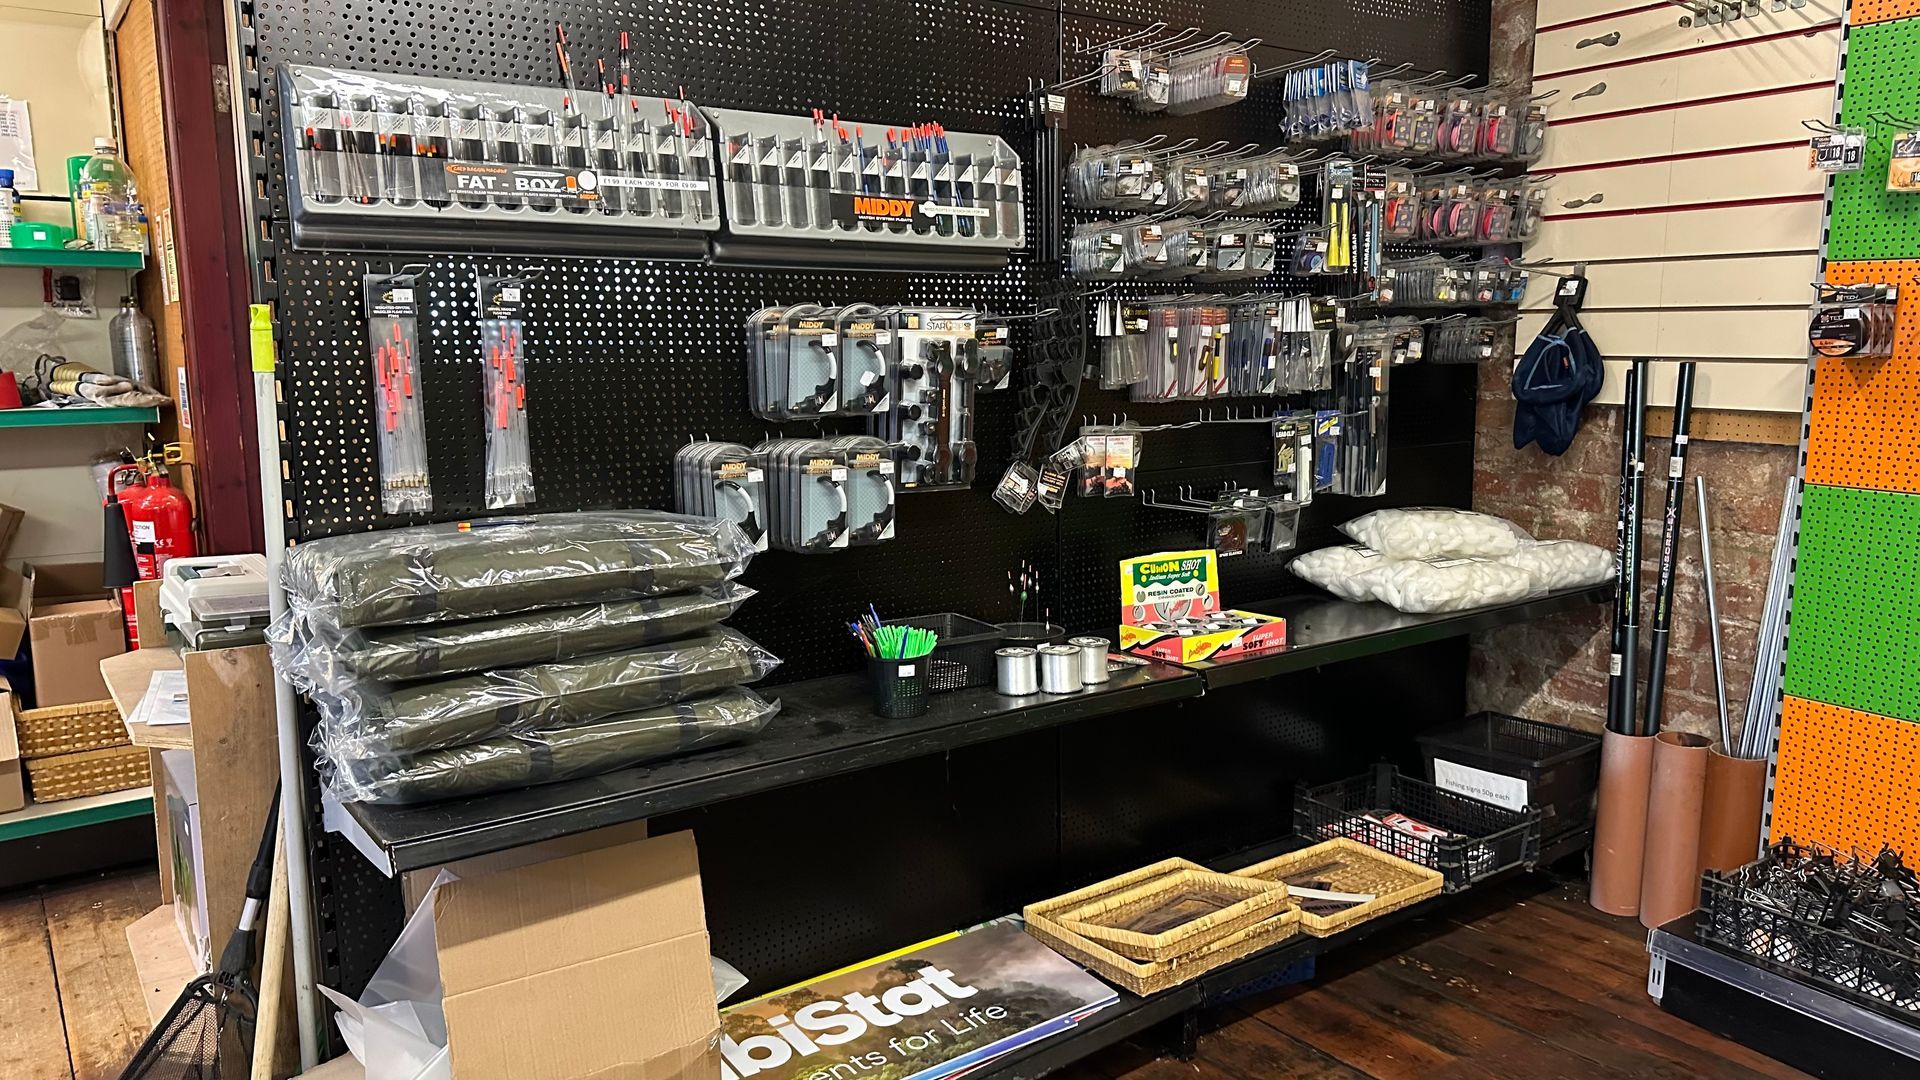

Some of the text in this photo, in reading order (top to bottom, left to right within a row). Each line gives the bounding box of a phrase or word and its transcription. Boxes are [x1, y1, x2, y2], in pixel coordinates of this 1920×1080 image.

[1833, 147, 1840, 157] 18
[1848, 151, 1856, 161] 18
[457, 175, 496, 190] FAT
[515, 178, 559, 192] BOY
[854, 196, 914, 217] MIDDY
[1363, 231, 1371, 272] KAMASAN
[799, 321, 824, 329] MIDDY
[850, 322, 875, 330] MIDDY
[809, 459, 834, 467] MIDDY
[856, 453, 880, 461] MIDDY
[721, 462, 747, 471] MIDDY
[1626, 504, 1634, 582] ZENSORFLEX
[1662, 507, 1676, 586] ZENSORFLEX
[1181, 559, 1201, 571] SHOT
[1252, 632, 1273, 641] SUPER
[1242, 637, 1284, 650] SOFT SHOT
[1152, 650, 1166, 658] SOFT
[1445, 779, 1465, 790] Fishing
[1466, 786, 1480, 794] signs
[1482, 789, 1493, 797] 50p
[721, 966, 979, 1080] biStat
[809, 1004, 1007, 1080] ents for Life
